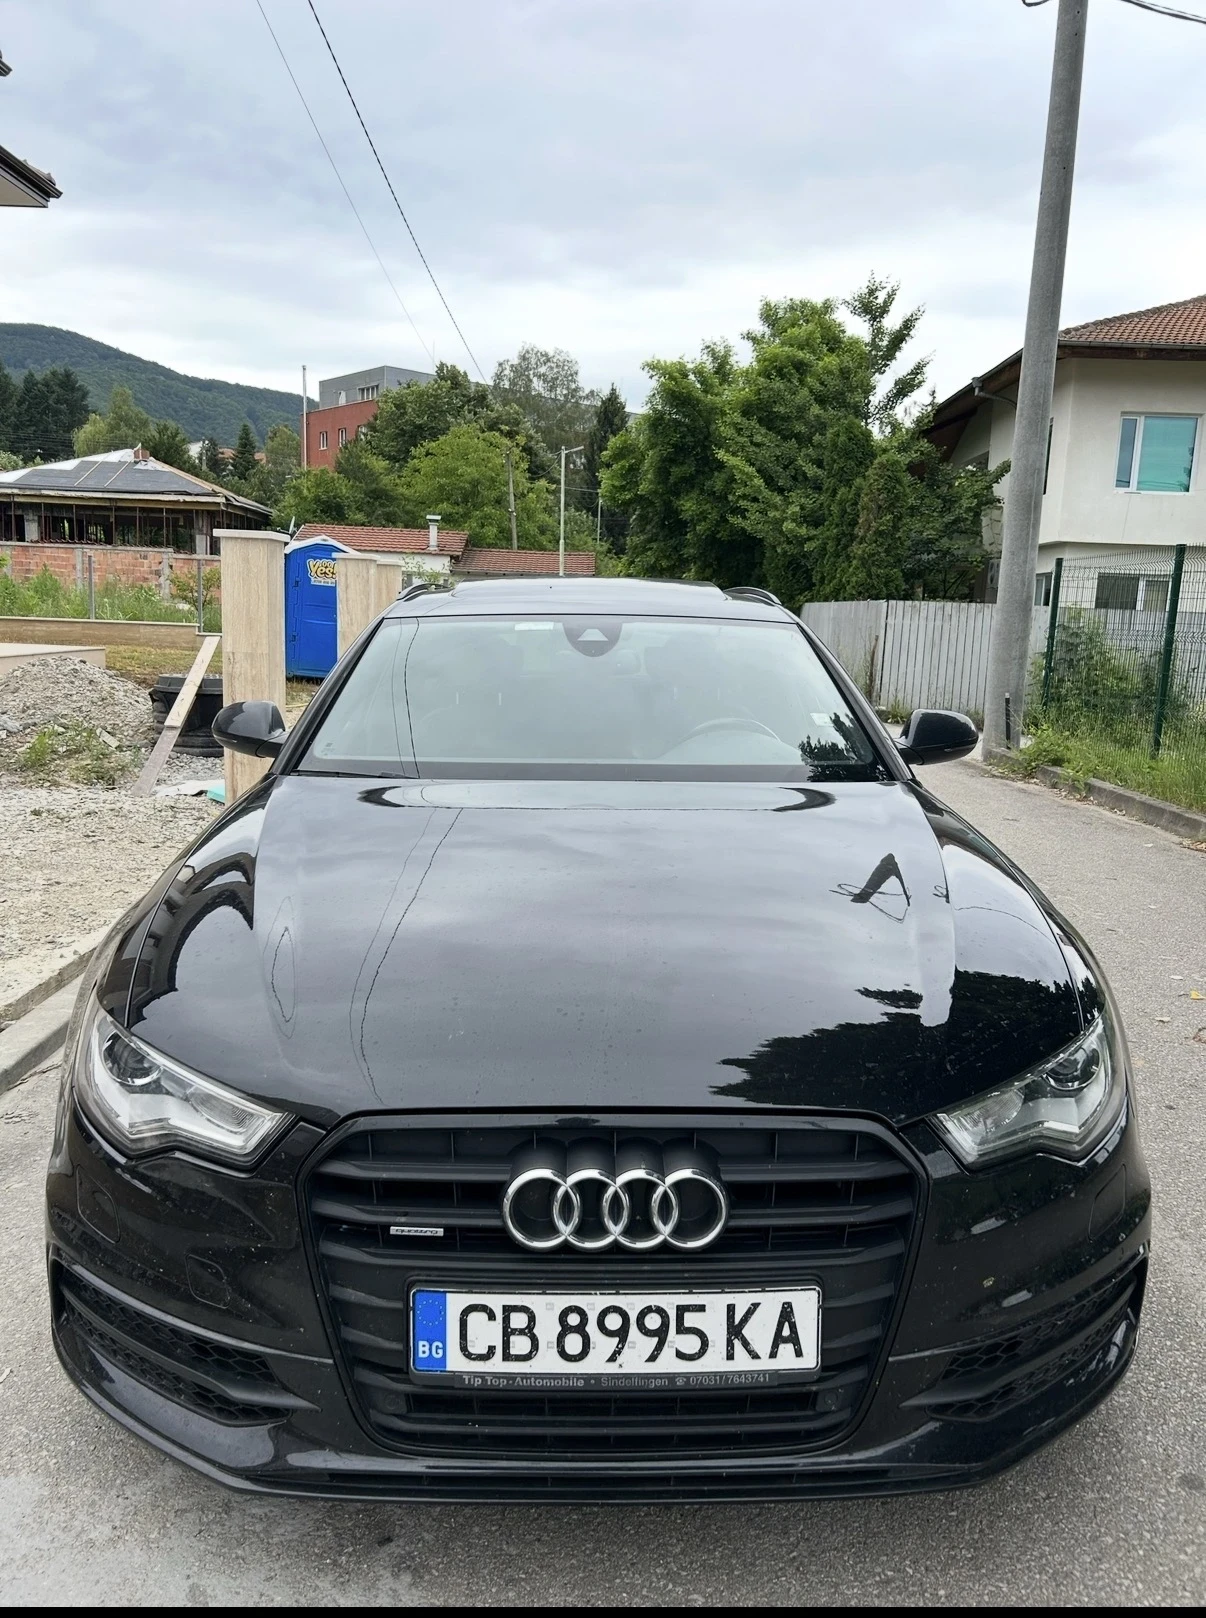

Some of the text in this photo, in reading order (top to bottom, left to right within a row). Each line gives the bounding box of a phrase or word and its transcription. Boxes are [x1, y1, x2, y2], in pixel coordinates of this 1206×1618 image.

[459, 1301, 804, 1363] CB 8995 KA
[418, 1341, 443, 1358] BG
[462, 1375, 482, 1386] Tip
[601, 1376, 668, 1388] Sindelfingen
[690, 1373, 769, 1385] 07031/7643741
